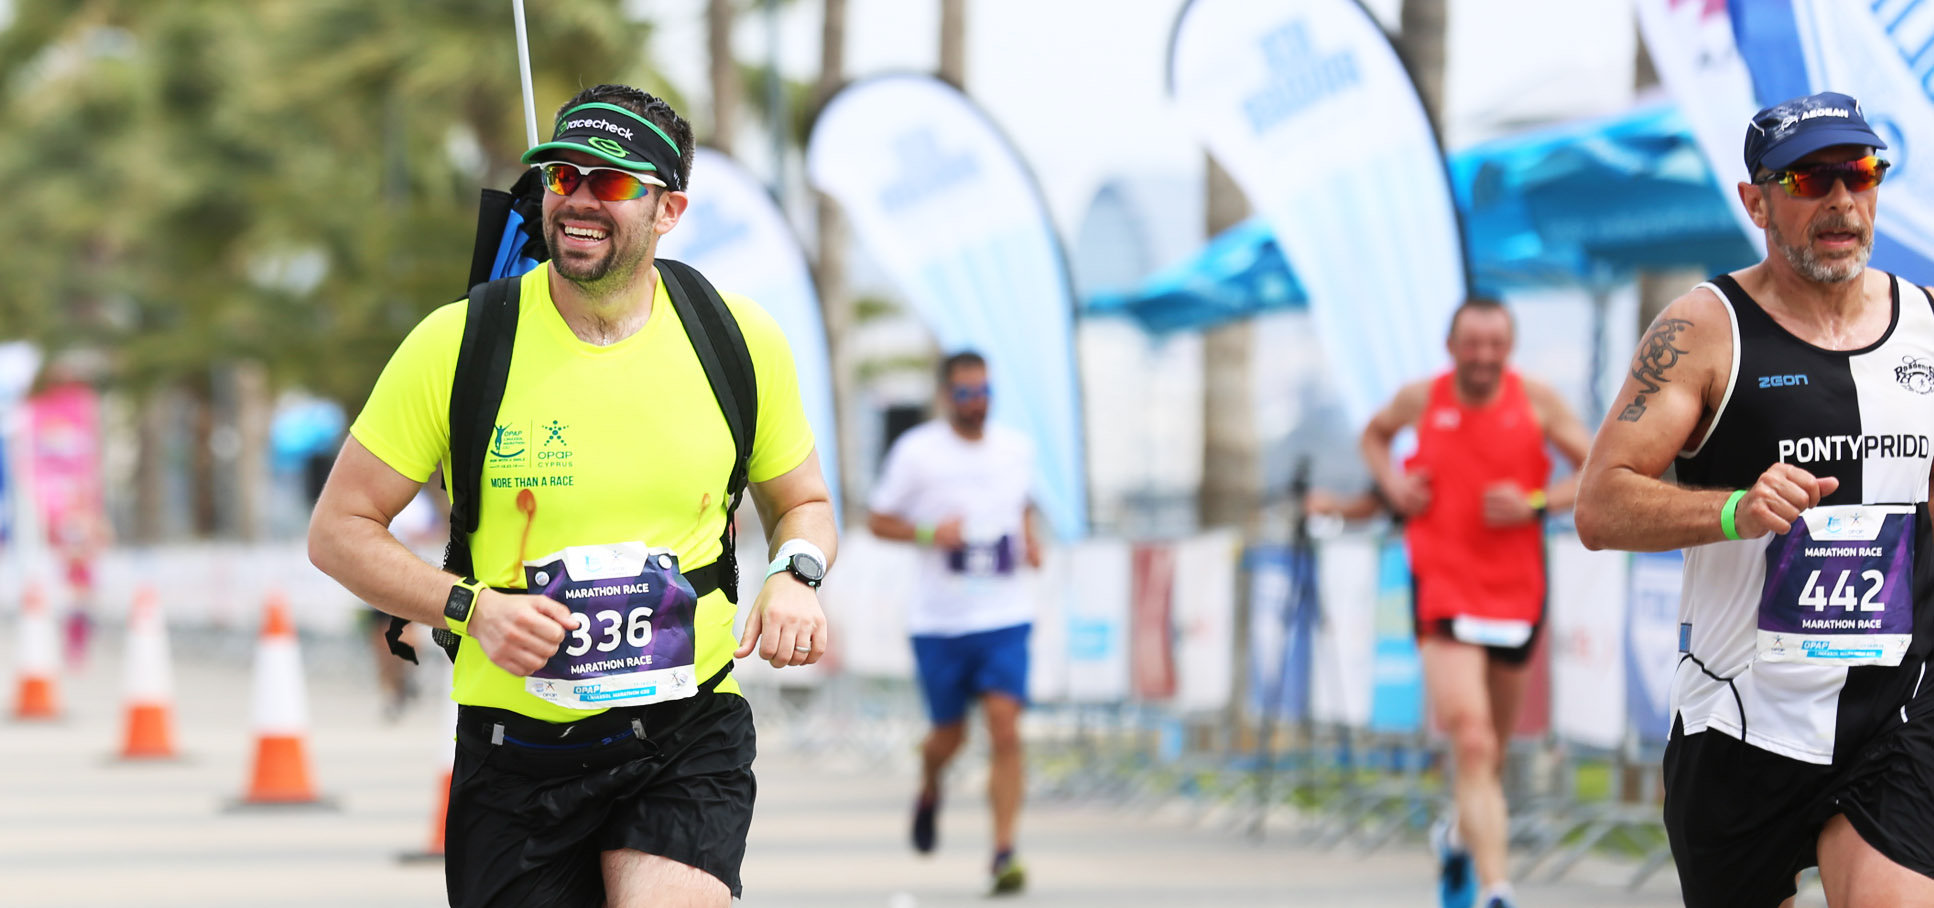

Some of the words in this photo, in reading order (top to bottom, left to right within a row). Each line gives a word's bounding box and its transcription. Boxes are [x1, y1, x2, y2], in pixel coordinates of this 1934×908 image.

[1801, 107, 1849, 120] AEGEAN
[566, 118, 634, 142] racecheck
[1778, 434, 1930, 464] PONTYPRIDD
[491, 477, 512, 488] MORE
[514, 476, 539, 488] THAN
[541, 476, 548, 487] A
[550, 475, 574, 486] RACE
[1804, 547, 1856, 558] MARATHON
[1858, 546, 1883, 557] RACE
[565, 585, 621, 600] MARATHON
[623, 583, 650, 595] RACE
[1798, 569, 1885, 612] 442
[565, 606, 654, 657] 336
[1802, 619, 1856, 629] MARATHON
[1857, 619, 1882, 629] RACE
[1804, 641, 1828, 649] OPAP
[570, 660, 625, 675] MARATHON
[626, 655, 653, 667] RACE
[575, 685, 600, 694] OPAP
